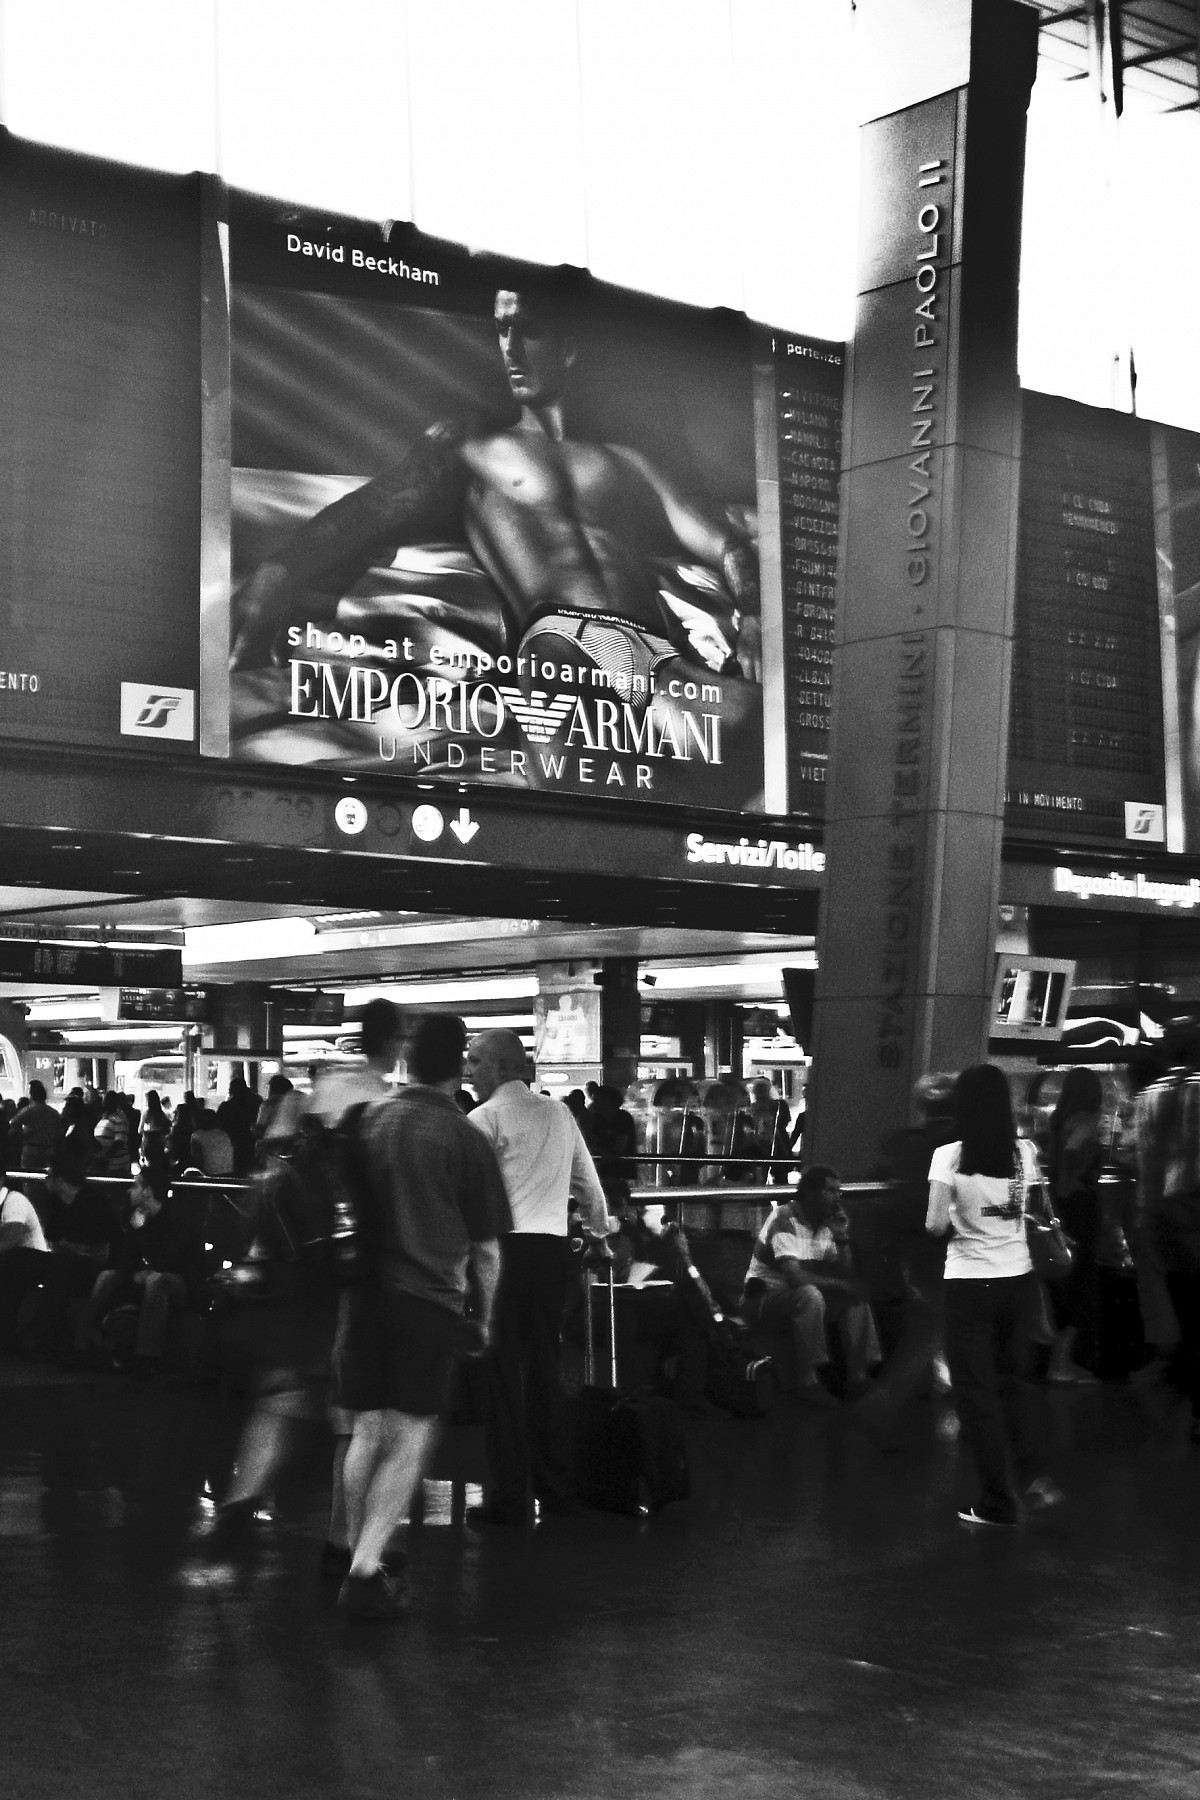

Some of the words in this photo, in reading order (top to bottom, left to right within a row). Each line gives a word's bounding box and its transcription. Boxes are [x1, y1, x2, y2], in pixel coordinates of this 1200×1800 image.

[918, 160, 941, 188] II
[287, 234, 343, 263] David
[352, 249, 439, 285] Beckham
[913, 203, 940, 348] PAOLO
[906, 368, 934, 587] GIOVANNI
[287, 622, 367, 658] shop
[383, 635, 415, 662] at
[429, 645, 722, 704] emporioarmani.com
[288, 659, 506, 737] EMPORIO
[565, 697, 723, 765] ARMANI
[379, 736, 654, 789] UNDERWEAR
[1019, 792, 1029, 804] IN
[1034, 794, 1084, 811] MOVIMENTO
[35, 1056, 51, 1070] 19
